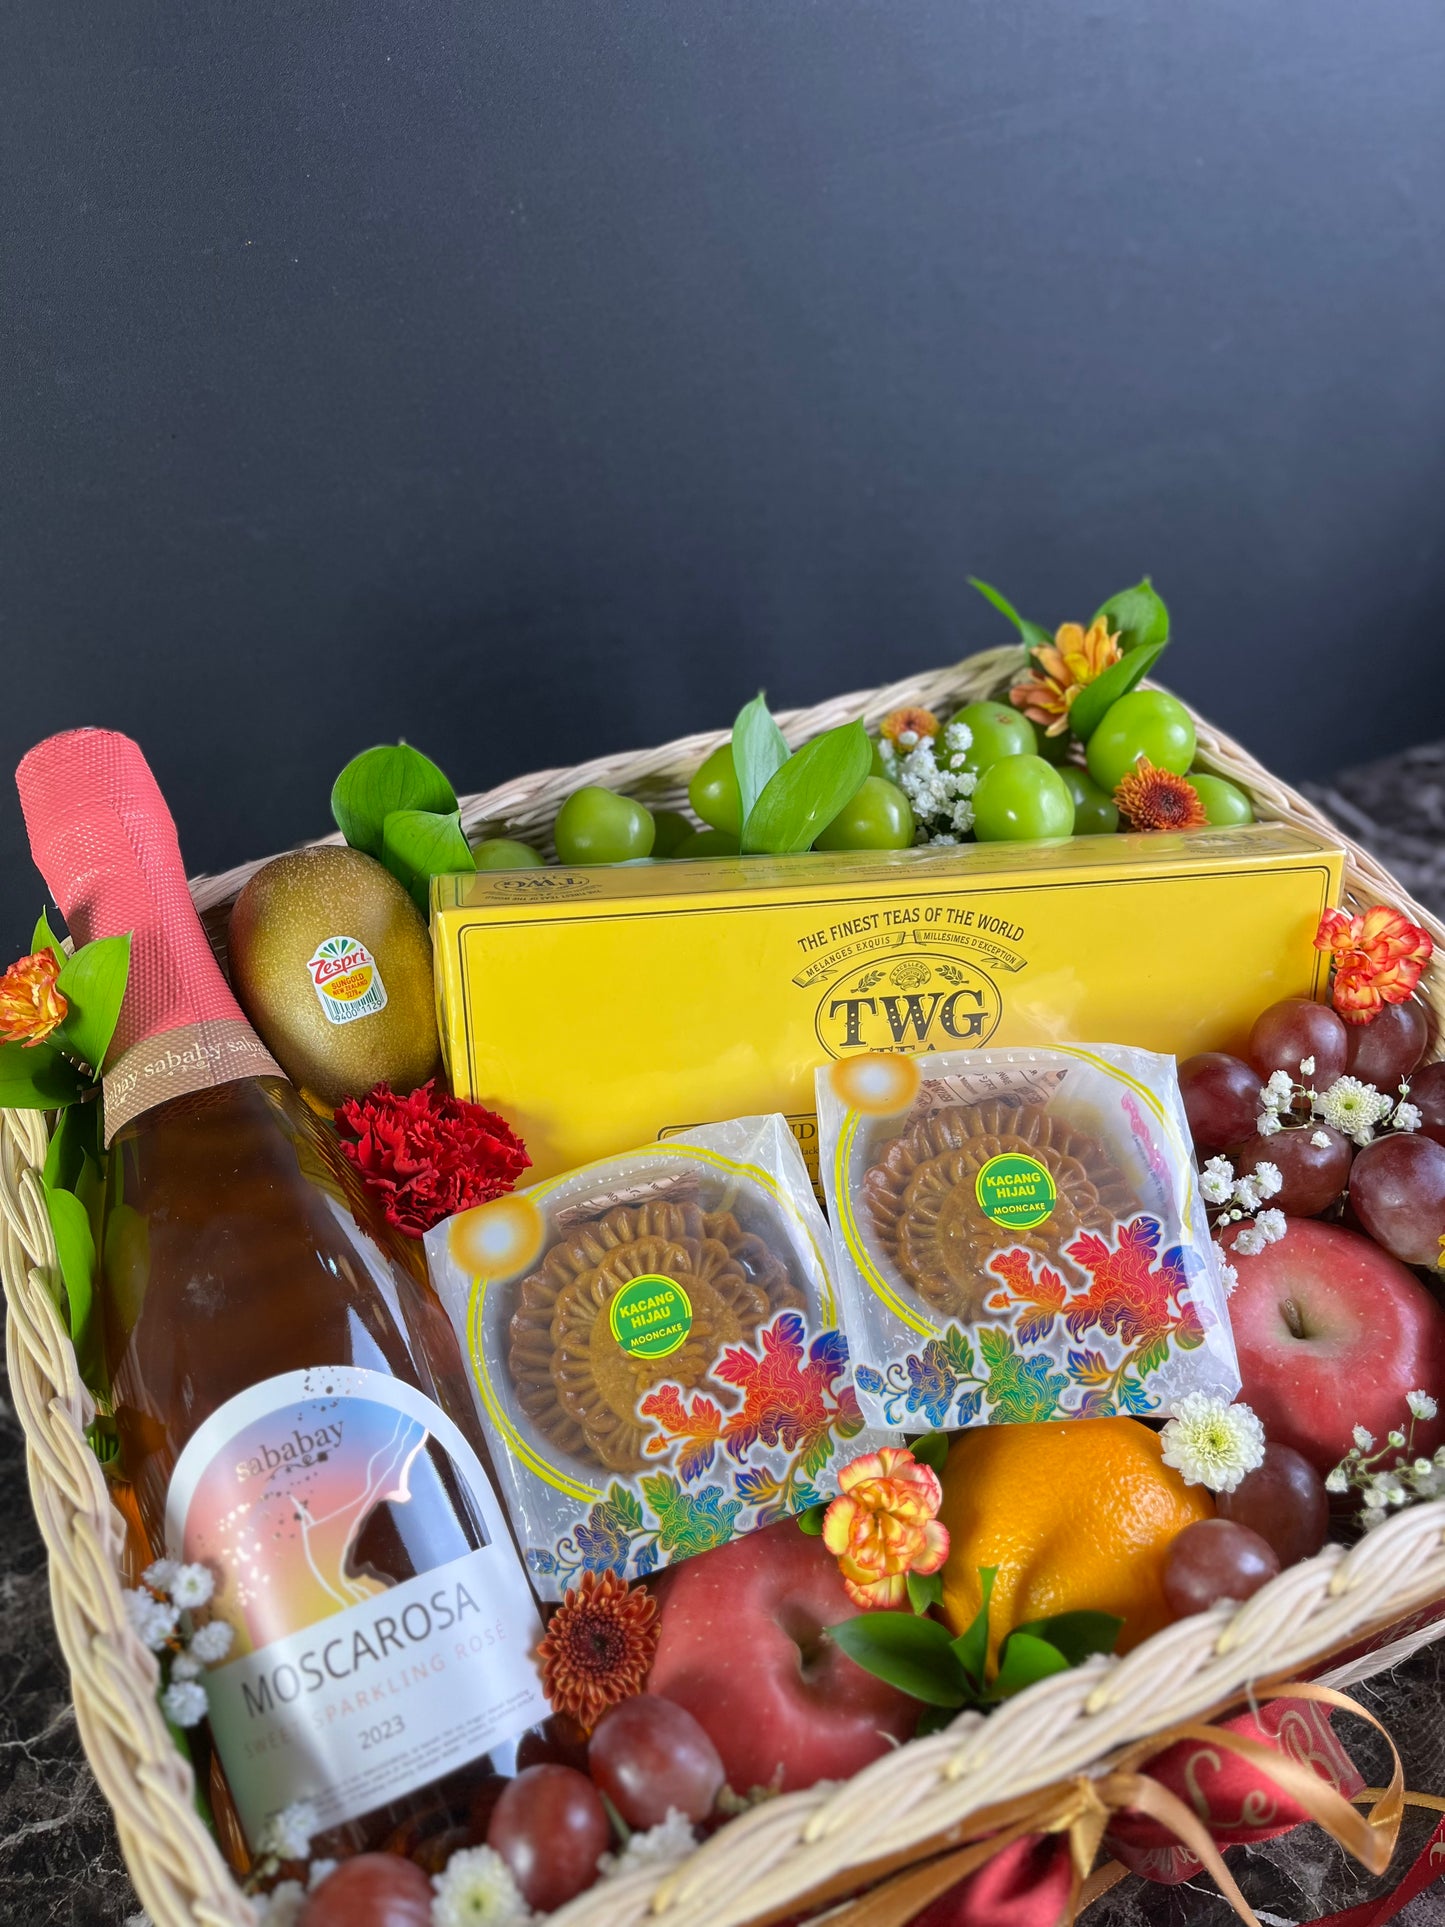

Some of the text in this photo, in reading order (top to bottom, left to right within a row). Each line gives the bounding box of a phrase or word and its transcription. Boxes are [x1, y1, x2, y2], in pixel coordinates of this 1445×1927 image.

[503, 877, 583, 889] TWG
[797, 907, 1026, 953] THE FINEST TEAS OF THE WORLD
[856, 935, 891, 952] EXQUIS
[970, 937, 1017, 965] D'EXCEPTION
[309, 948, 367, 984] Zespri
[331, 973, 365, 990] SUNGOLD
[332, 979, 368, 996] NEW ZEALAND
[335, 1000, 382, 1022] 9400 1129
[829, 989, 989, 1048] TWG
[985, 1172, 1042, 1187] KACANG
[996, 1184, 1036, 1199] HIJAU
[993, 1202, 1046, 1215] MOONCAKE
[619, 1291, 675, 1318] KACANG
[630, 1305, 671, 1329] HIJAU
[630, 1322, 683, 1347] MOONCAKE
[236, 1420, 344, 1483] sababay
[241, 1582, 481, 1719] MOSCAROSA
[312, 1655, 447, 1729] SPARKLING
[358, 1715, 406, 1750] 2023
